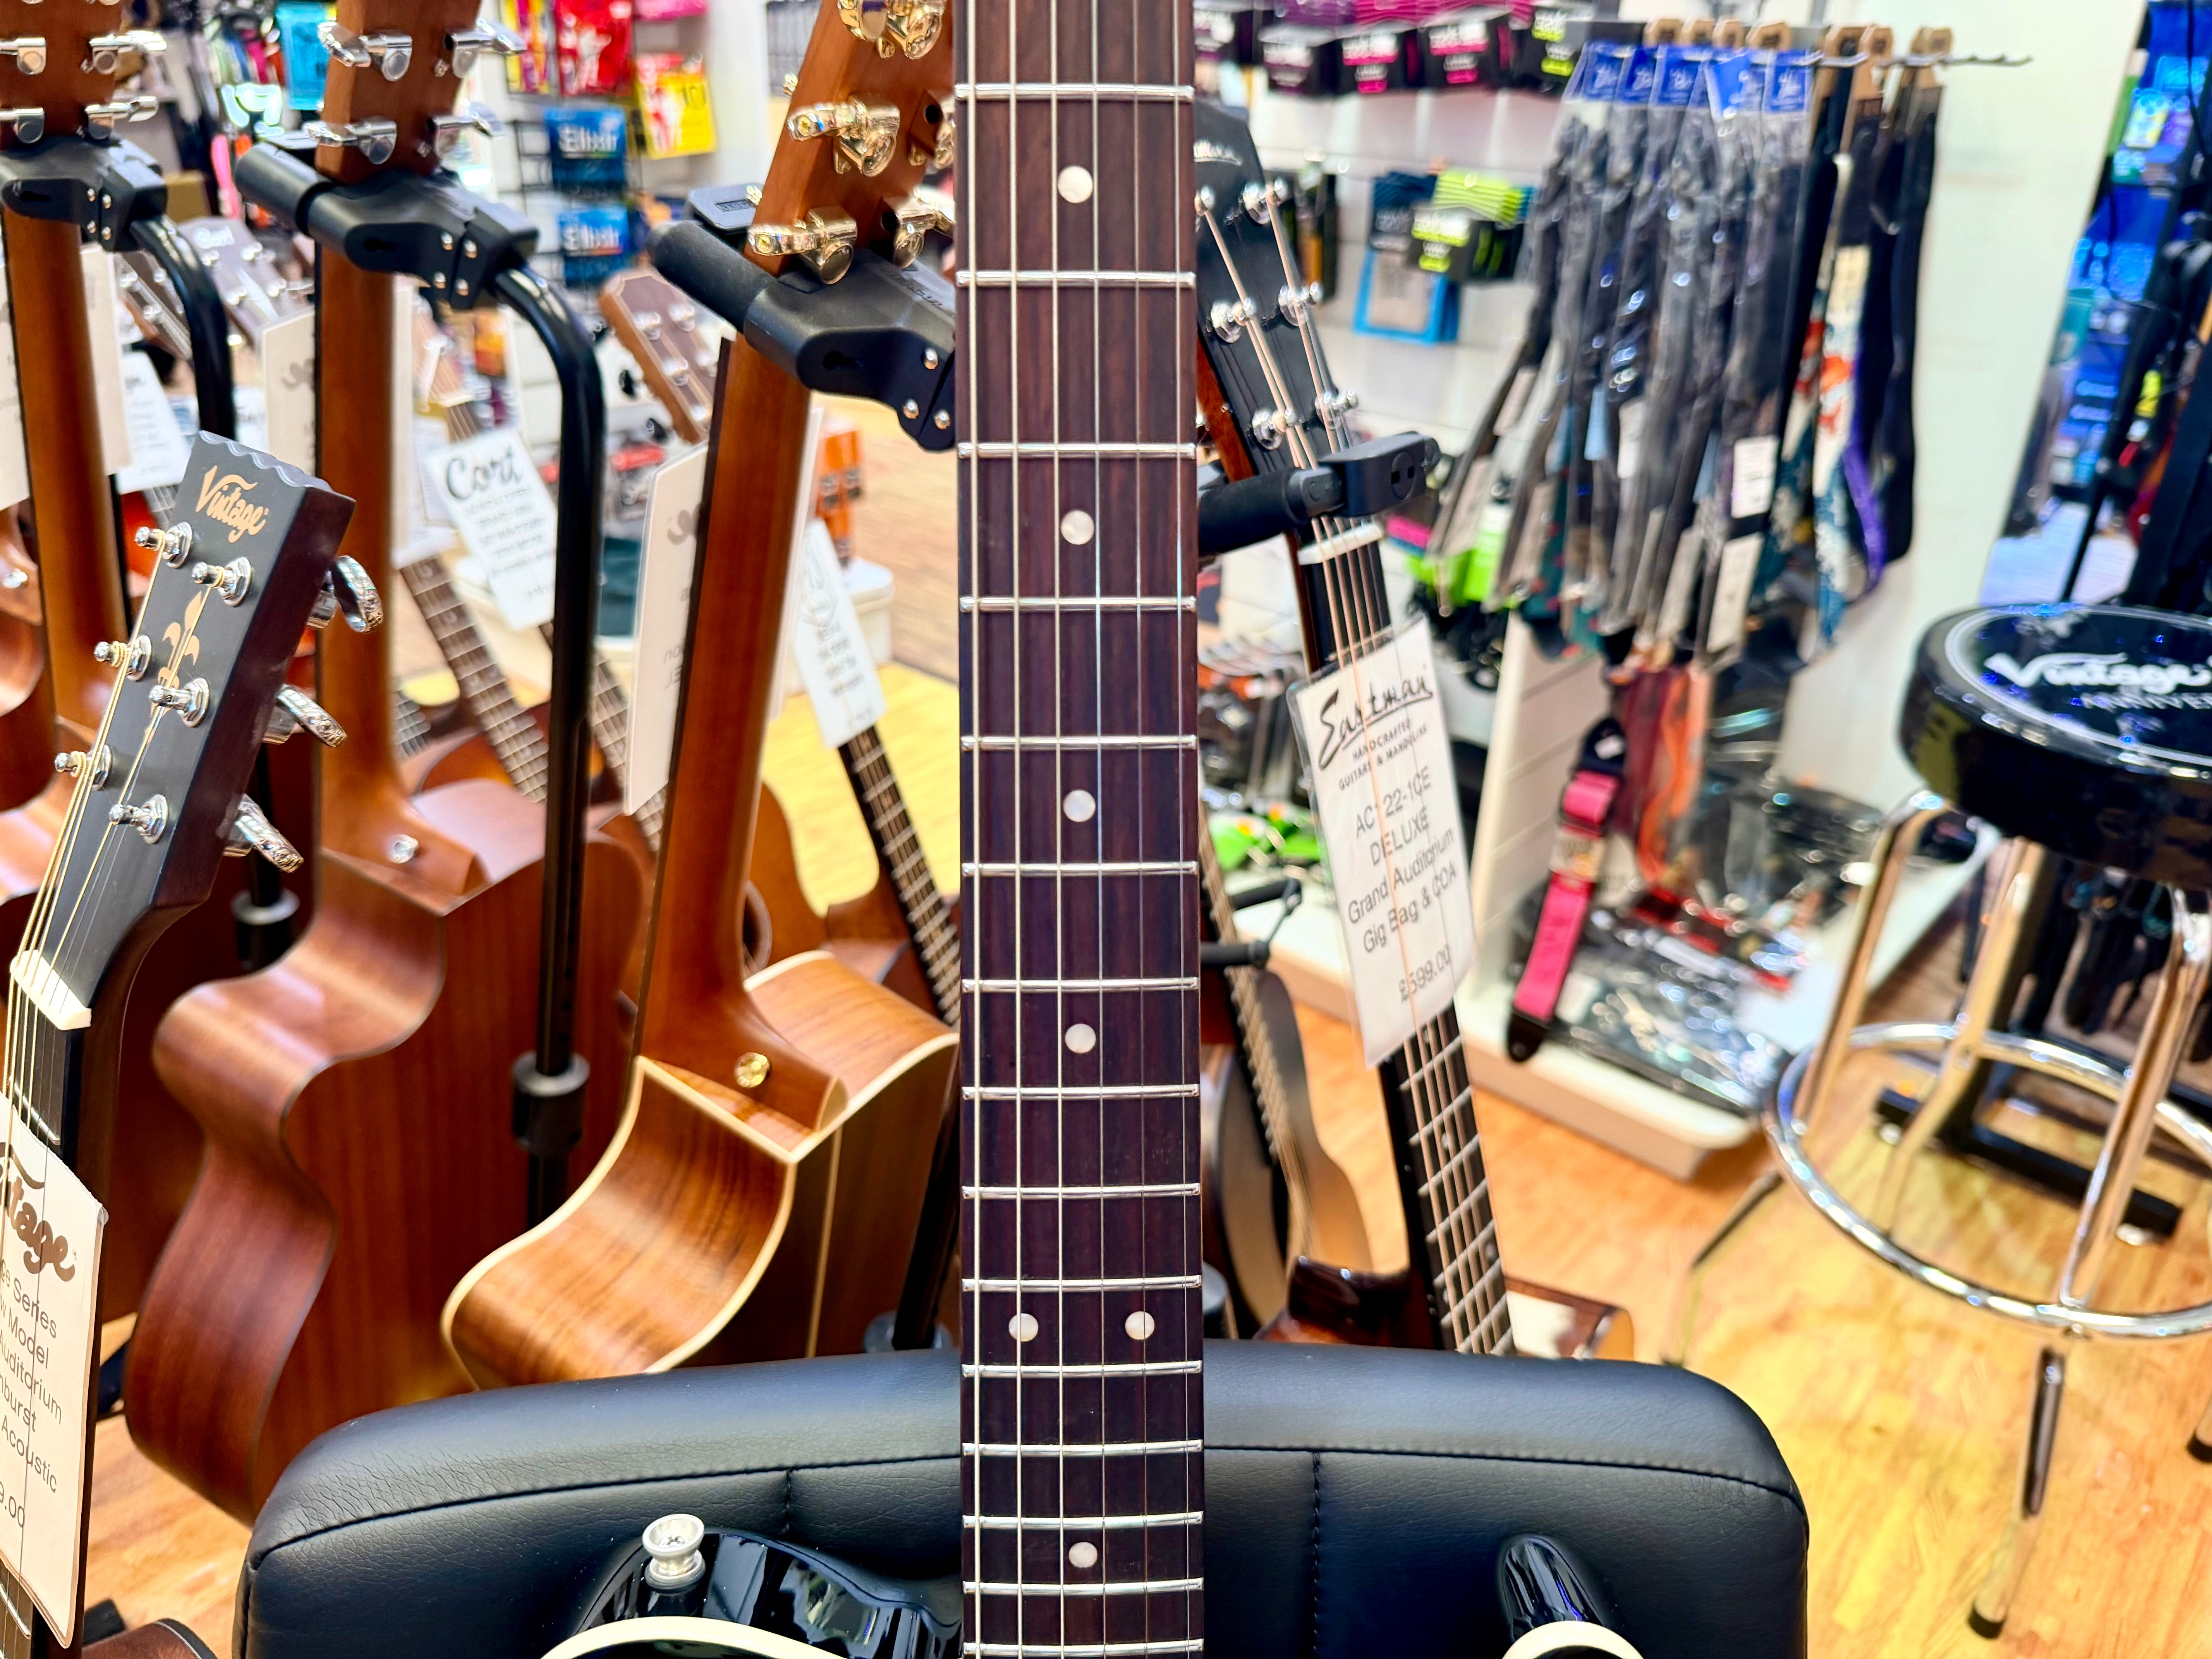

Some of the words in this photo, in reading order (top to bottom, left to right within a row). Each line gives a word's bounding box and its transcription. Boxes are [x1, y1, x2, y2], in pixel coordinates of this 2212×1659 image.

[196, 465, 266, 543] Vintage
[1319, 676, 1432, 771] Eastman
[1370, 805, 1428, 865] DELUXE
[1348, 876, 1389, 924] Grand
[1394, 828, 1454, 891] Auditorium
[1363, 924, 1386, 953] Gig
[1388, 899, 1419, 932] Bag
[1421, 886, 1431, 909] &
[1432, 860, 1456, 897] COA
[0, 1142, 75, 1282] tage
[9, 1307, 49, 1369] Model
[14, 1278, 57, 1339] Series
[0, 1373, 36, 1432] nburst
[2, 1415, 57, 1493] Acoustic
[0, 1481, 25, 1528] 9.00
